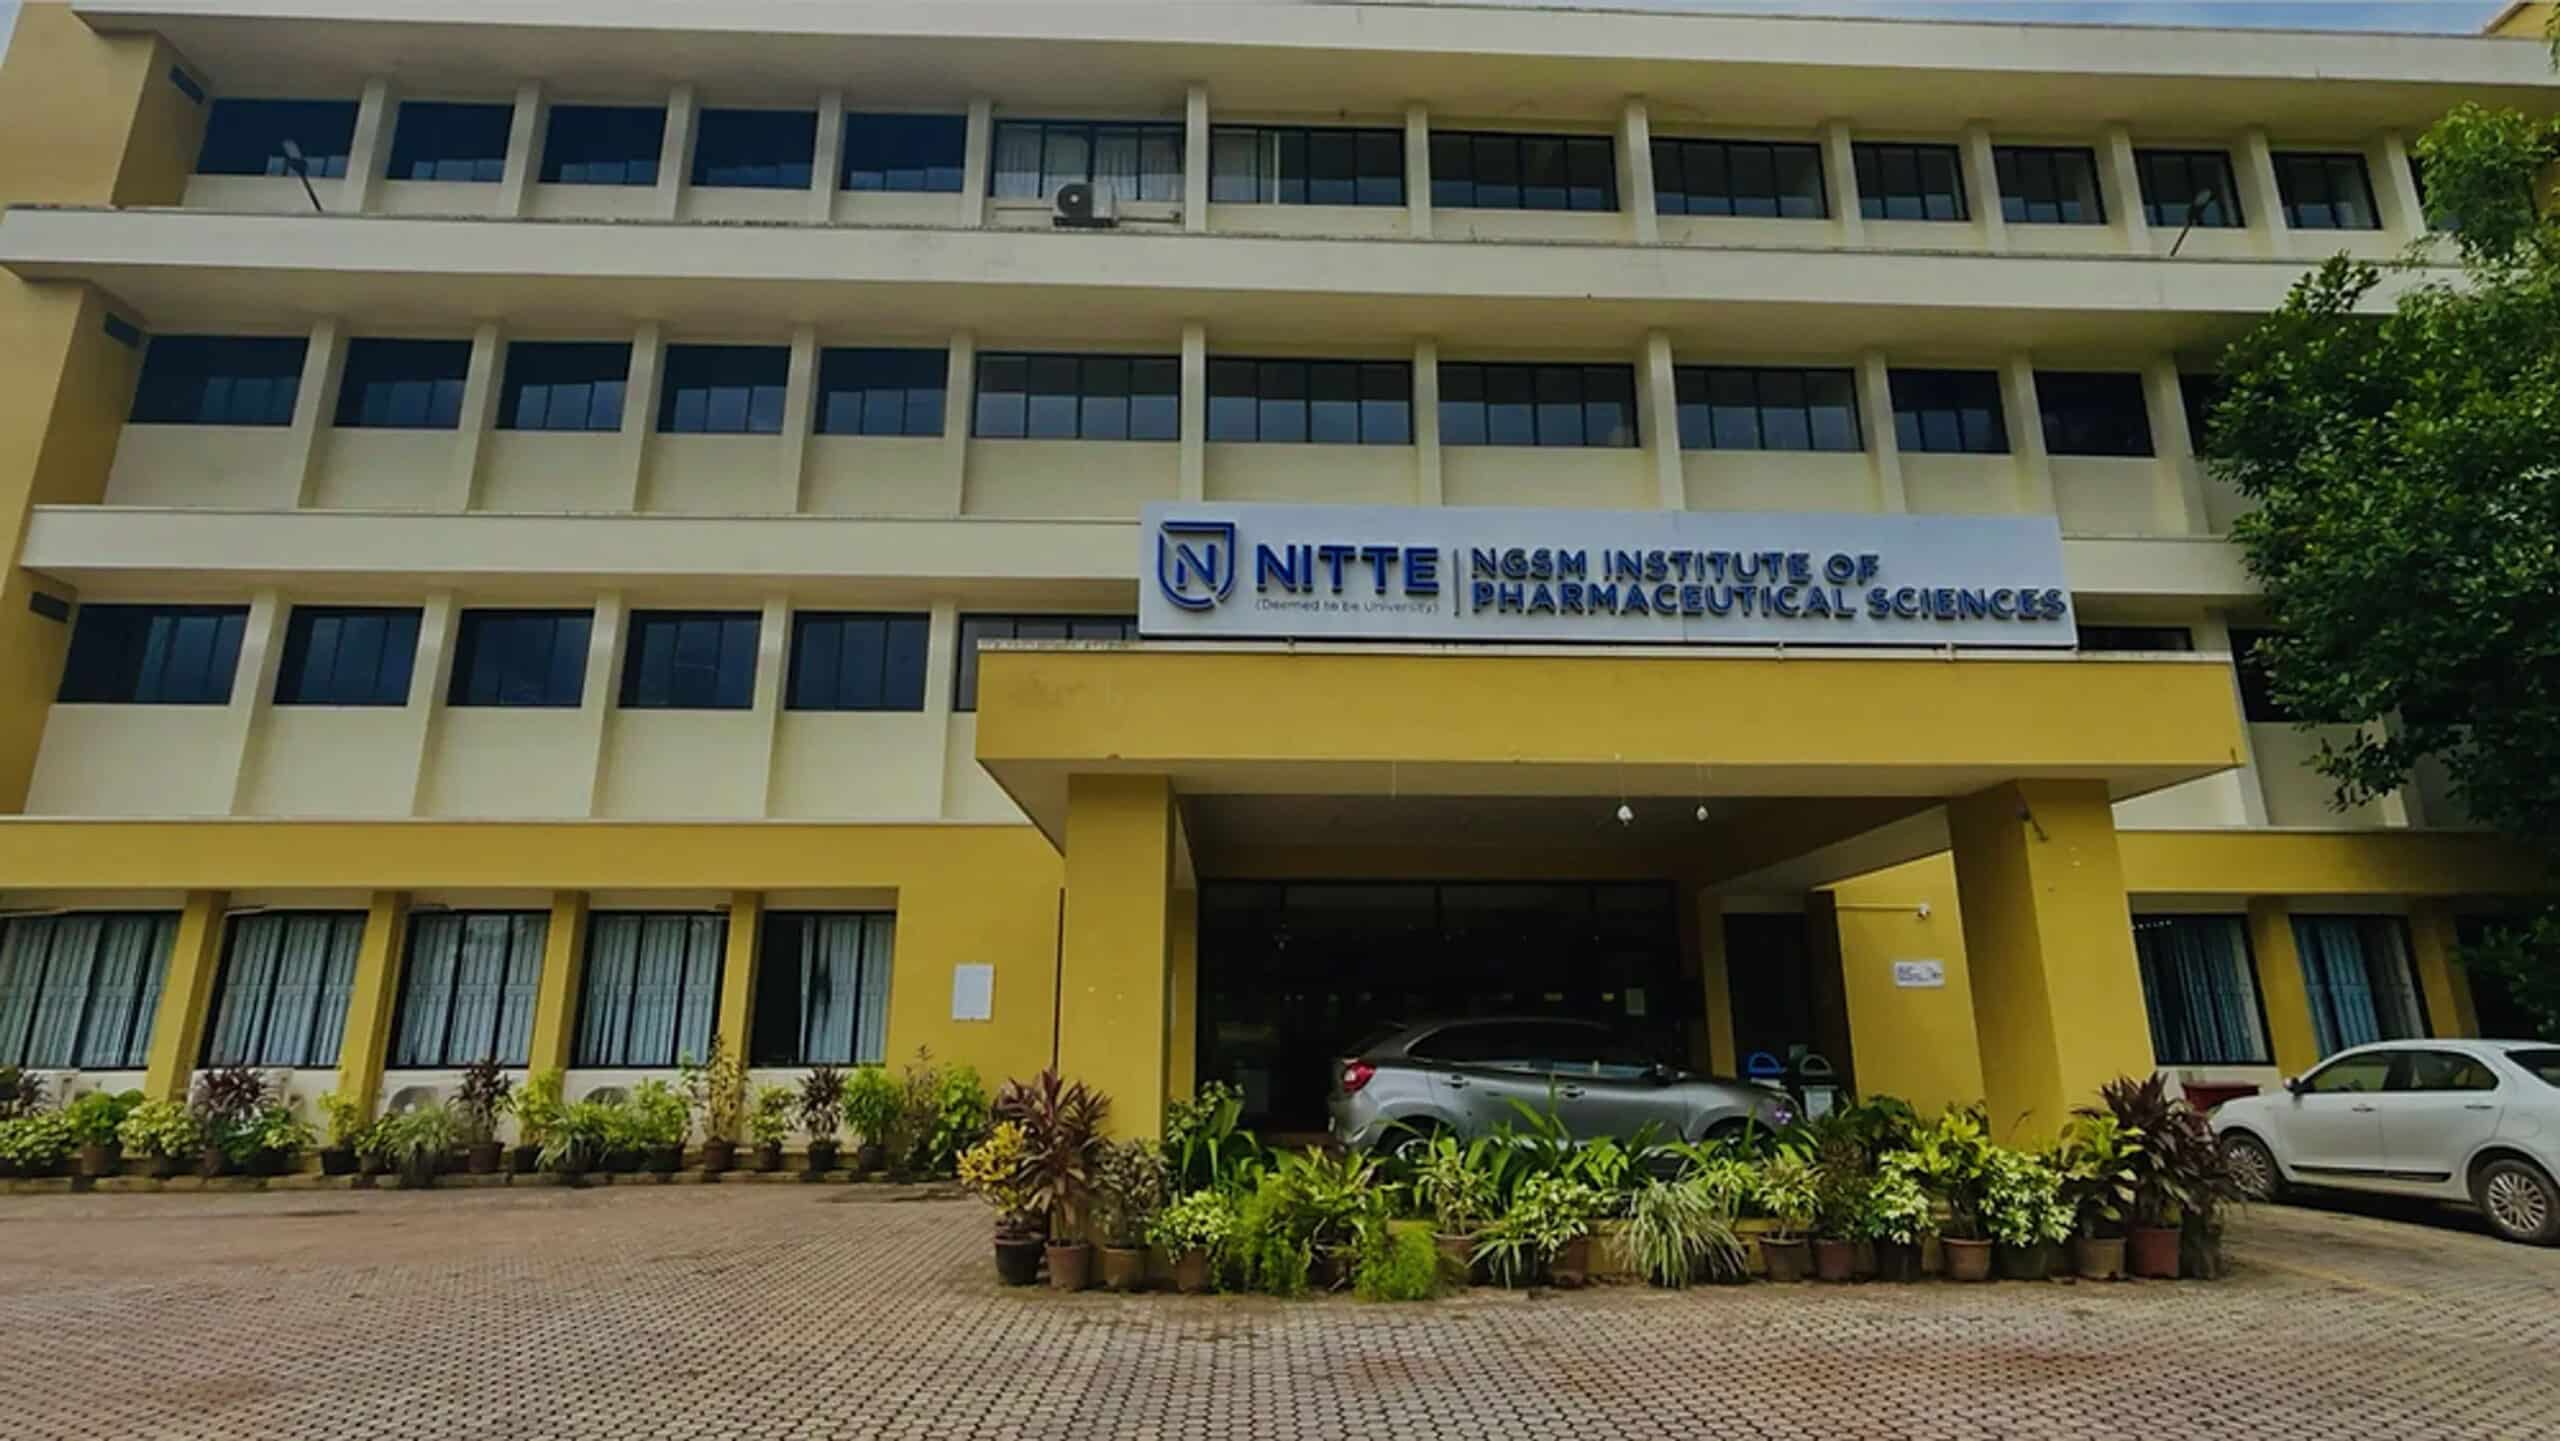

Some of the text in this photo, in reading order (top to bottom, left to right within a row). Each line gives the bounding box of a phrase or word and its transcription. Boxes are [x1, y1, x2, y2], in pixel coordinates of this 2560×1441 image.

[1256, 543, 1440, 596] NITTE
[1470, 547, 1880, 586] NGSM INSTITUTE OF
[1255, 600, 1440, 615] (Deemed to be University)
[1470, 580, 2068, 621] PHARMACEUTICAL SCIENCES
